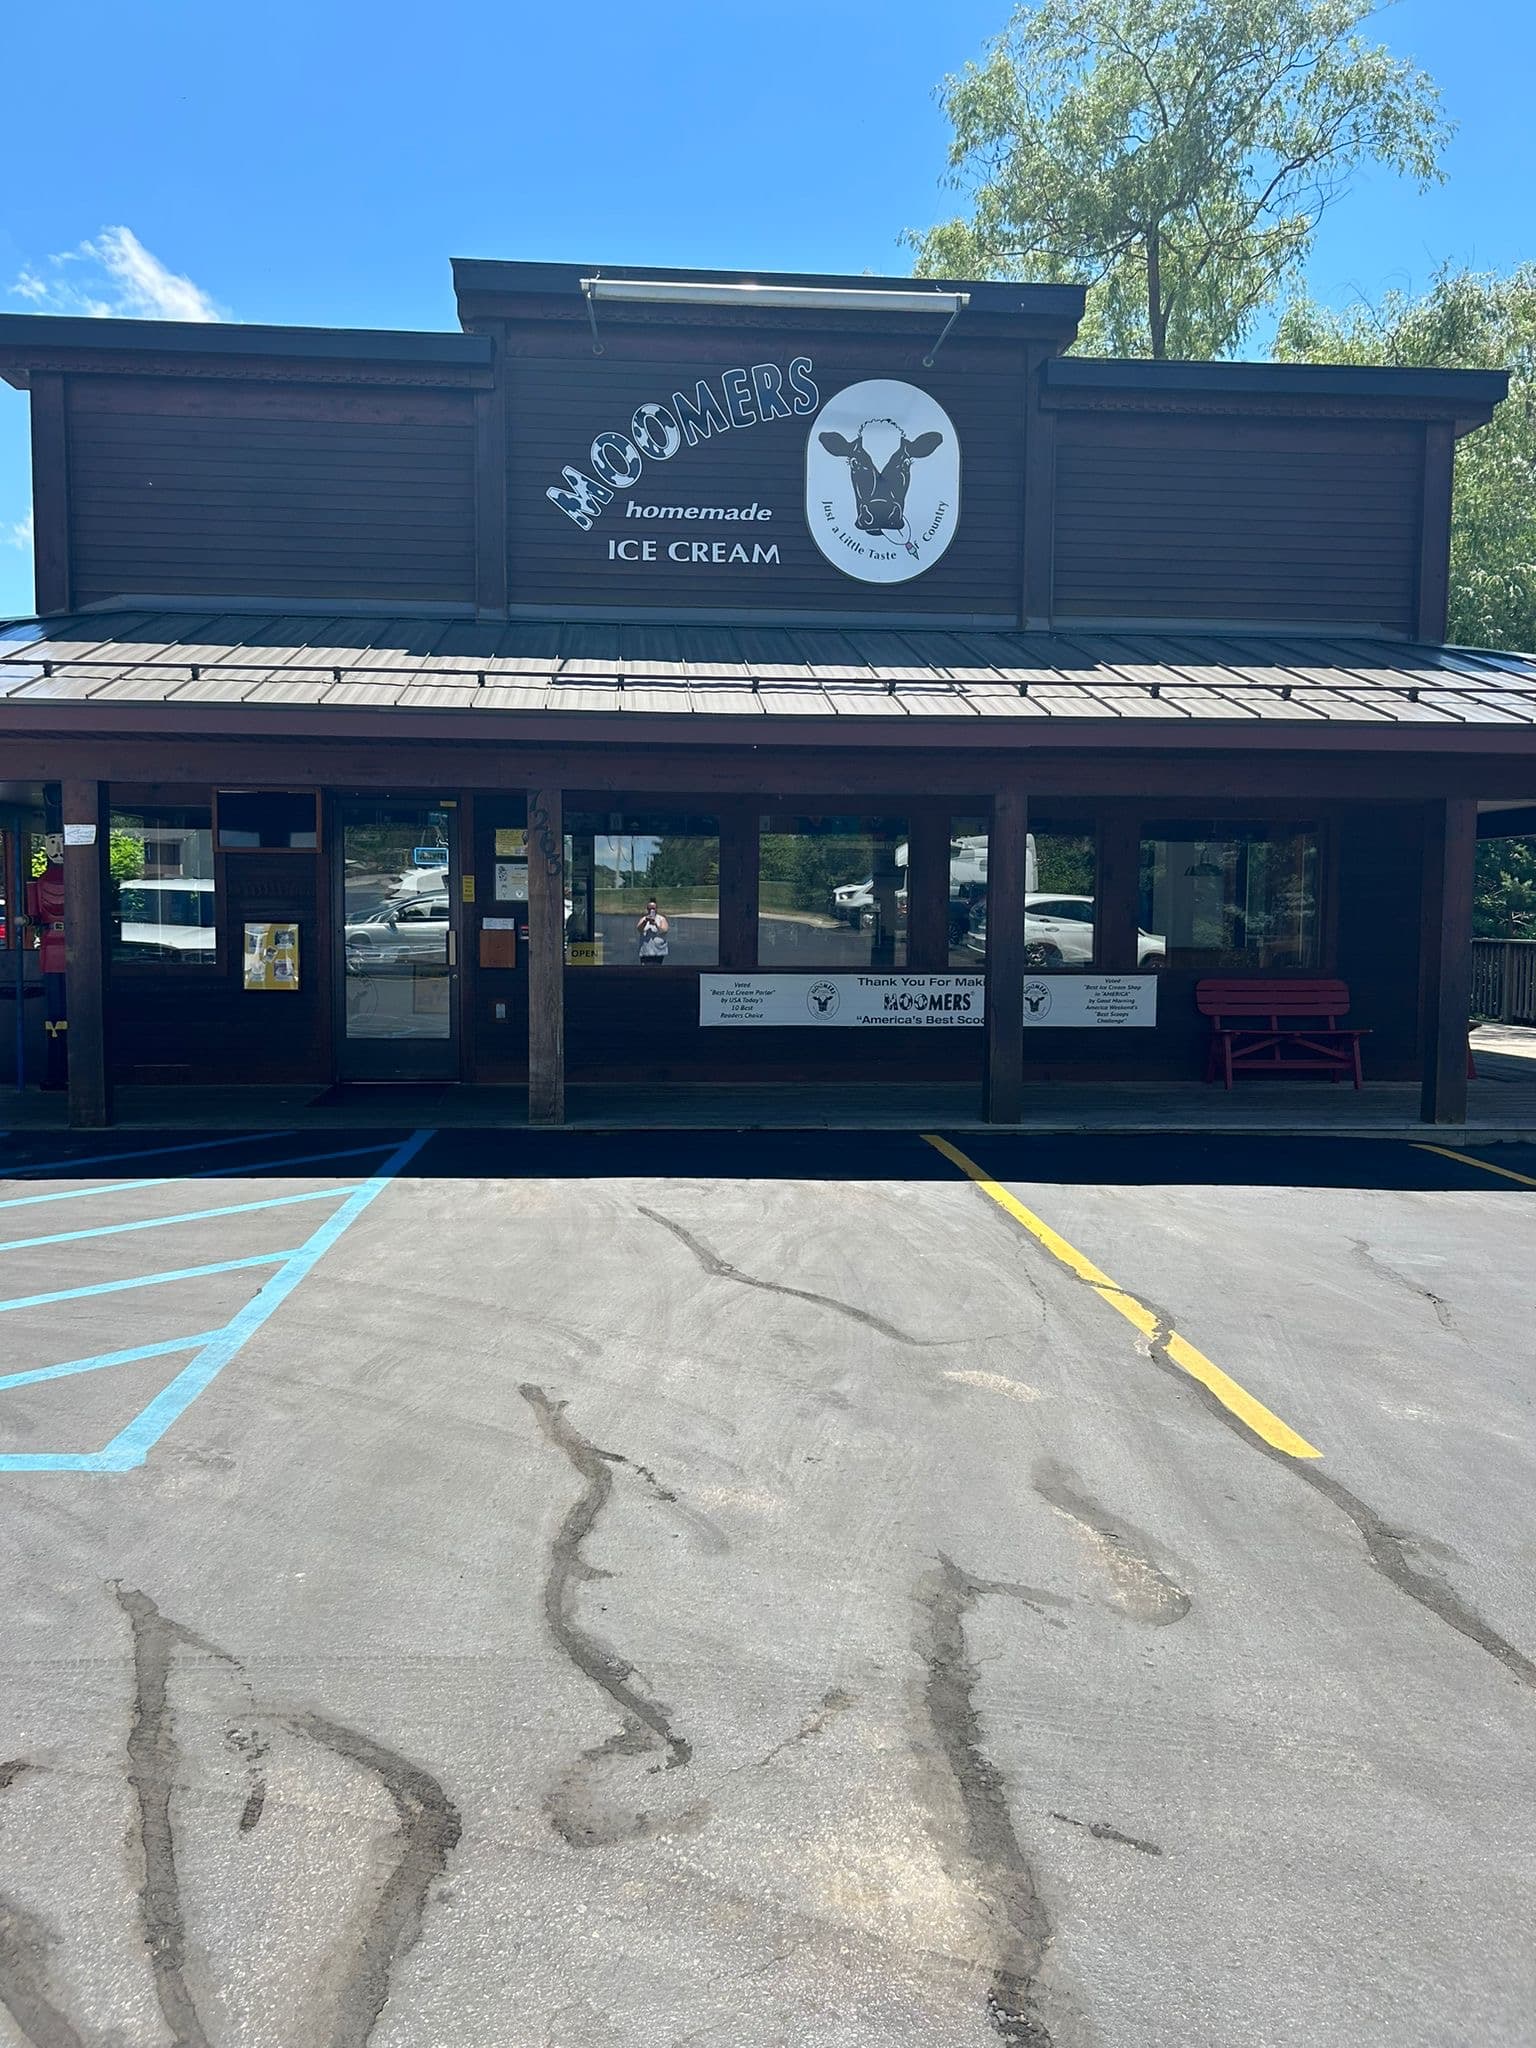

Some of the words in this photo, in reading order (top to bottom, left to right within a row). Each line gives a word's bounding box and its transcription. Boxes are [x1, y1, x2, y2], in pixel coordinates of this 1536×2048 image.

[546, 356, 820, 532] MOOMERS
[625, 500, 772, 521] homemade
[821, 499, 836, 522] Just
[831, 526, 839, 534] a
[838, 532, 865, 555] Little
[868, 548, 897, 561] Taste
[922, 500, 950, 542] Country
[608, 539, 657, 562] ICE
[667, 541, 781, 565] CREAM
[528, 788, 562, 876] 7263
[571, 949, 600, 958] OPEN
[857, 977, 898, 987] Thank
[901, 977, 925, 987] You
[929, 977, 951, 987] For
[884, 992, 971, 1011] MOOMERS
[856, 1015, 922, 1024] "America's
[926, 1015, 954, 1024] Best
